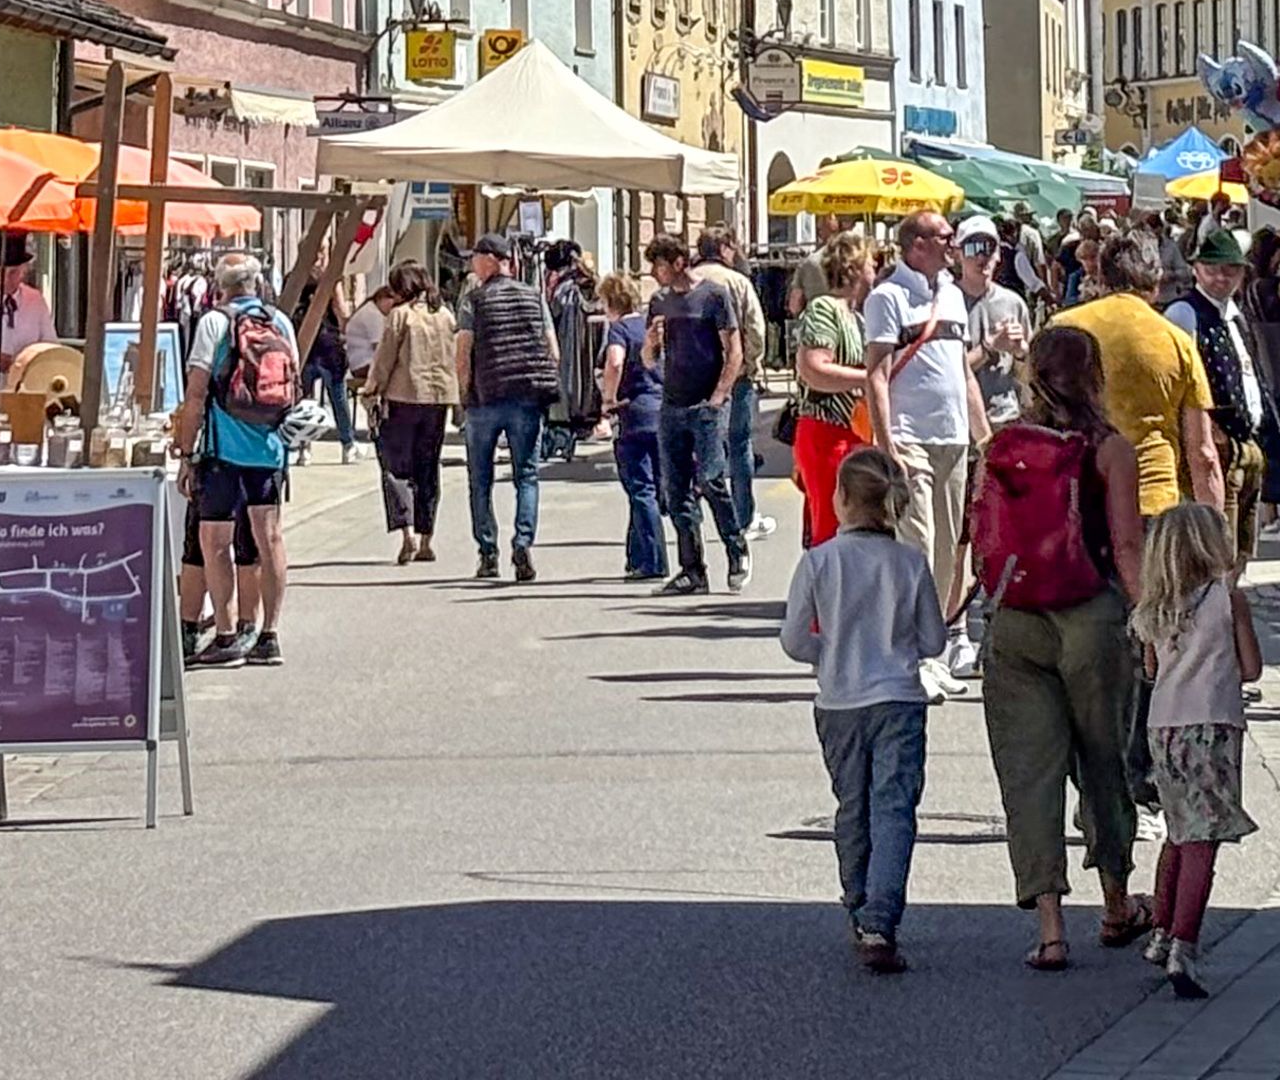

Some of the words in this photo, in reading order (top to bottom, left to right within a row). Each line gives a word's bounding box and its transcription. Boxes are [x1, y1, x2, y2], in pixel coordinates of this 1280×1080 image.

[412, 57, 448, 68] LOTTO
[322, 117, 361, 128] Allianz
[11, 524, 45, 537] finde
[48, 523, 68, 537] ich
[72, 522, 105, 537] was?
